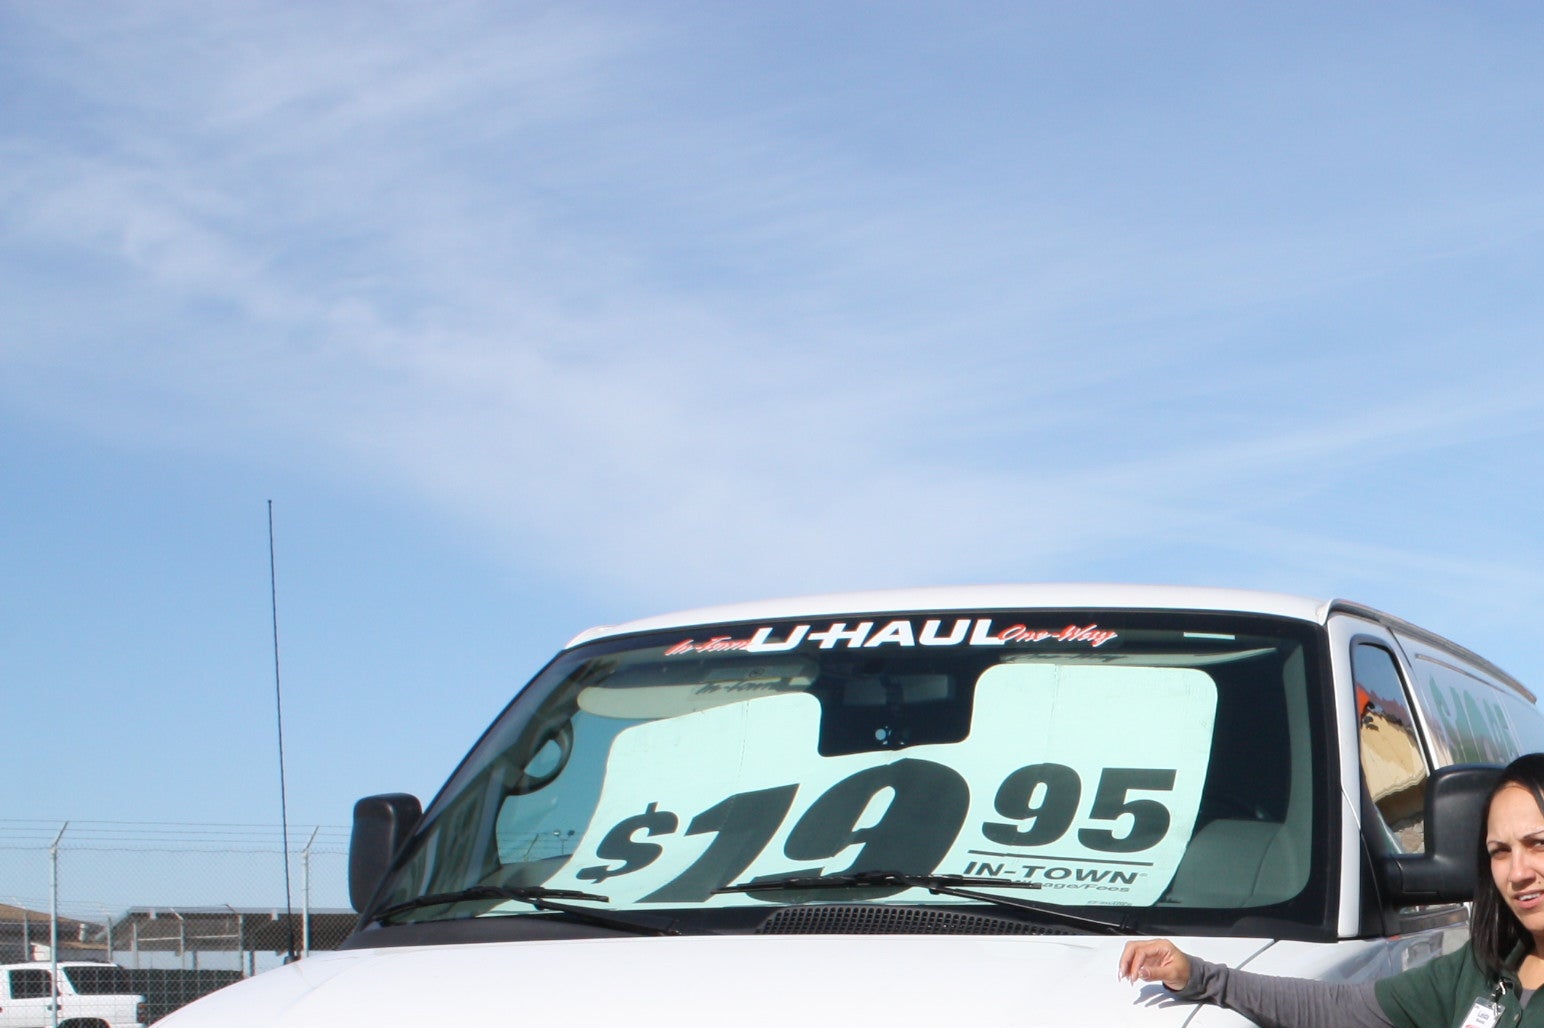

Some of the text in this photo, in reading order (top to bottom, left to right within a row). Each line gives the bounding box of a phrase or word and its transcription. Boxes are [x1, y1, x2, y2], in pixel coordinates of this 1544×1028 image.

[747, 618, 1005, 652] U-HAUL
[998, 623, 1118, 648] One-Way
[963, 860, 1138, 885] IN-TOWN
[1011, 879, 1131, 893] age/Fees
